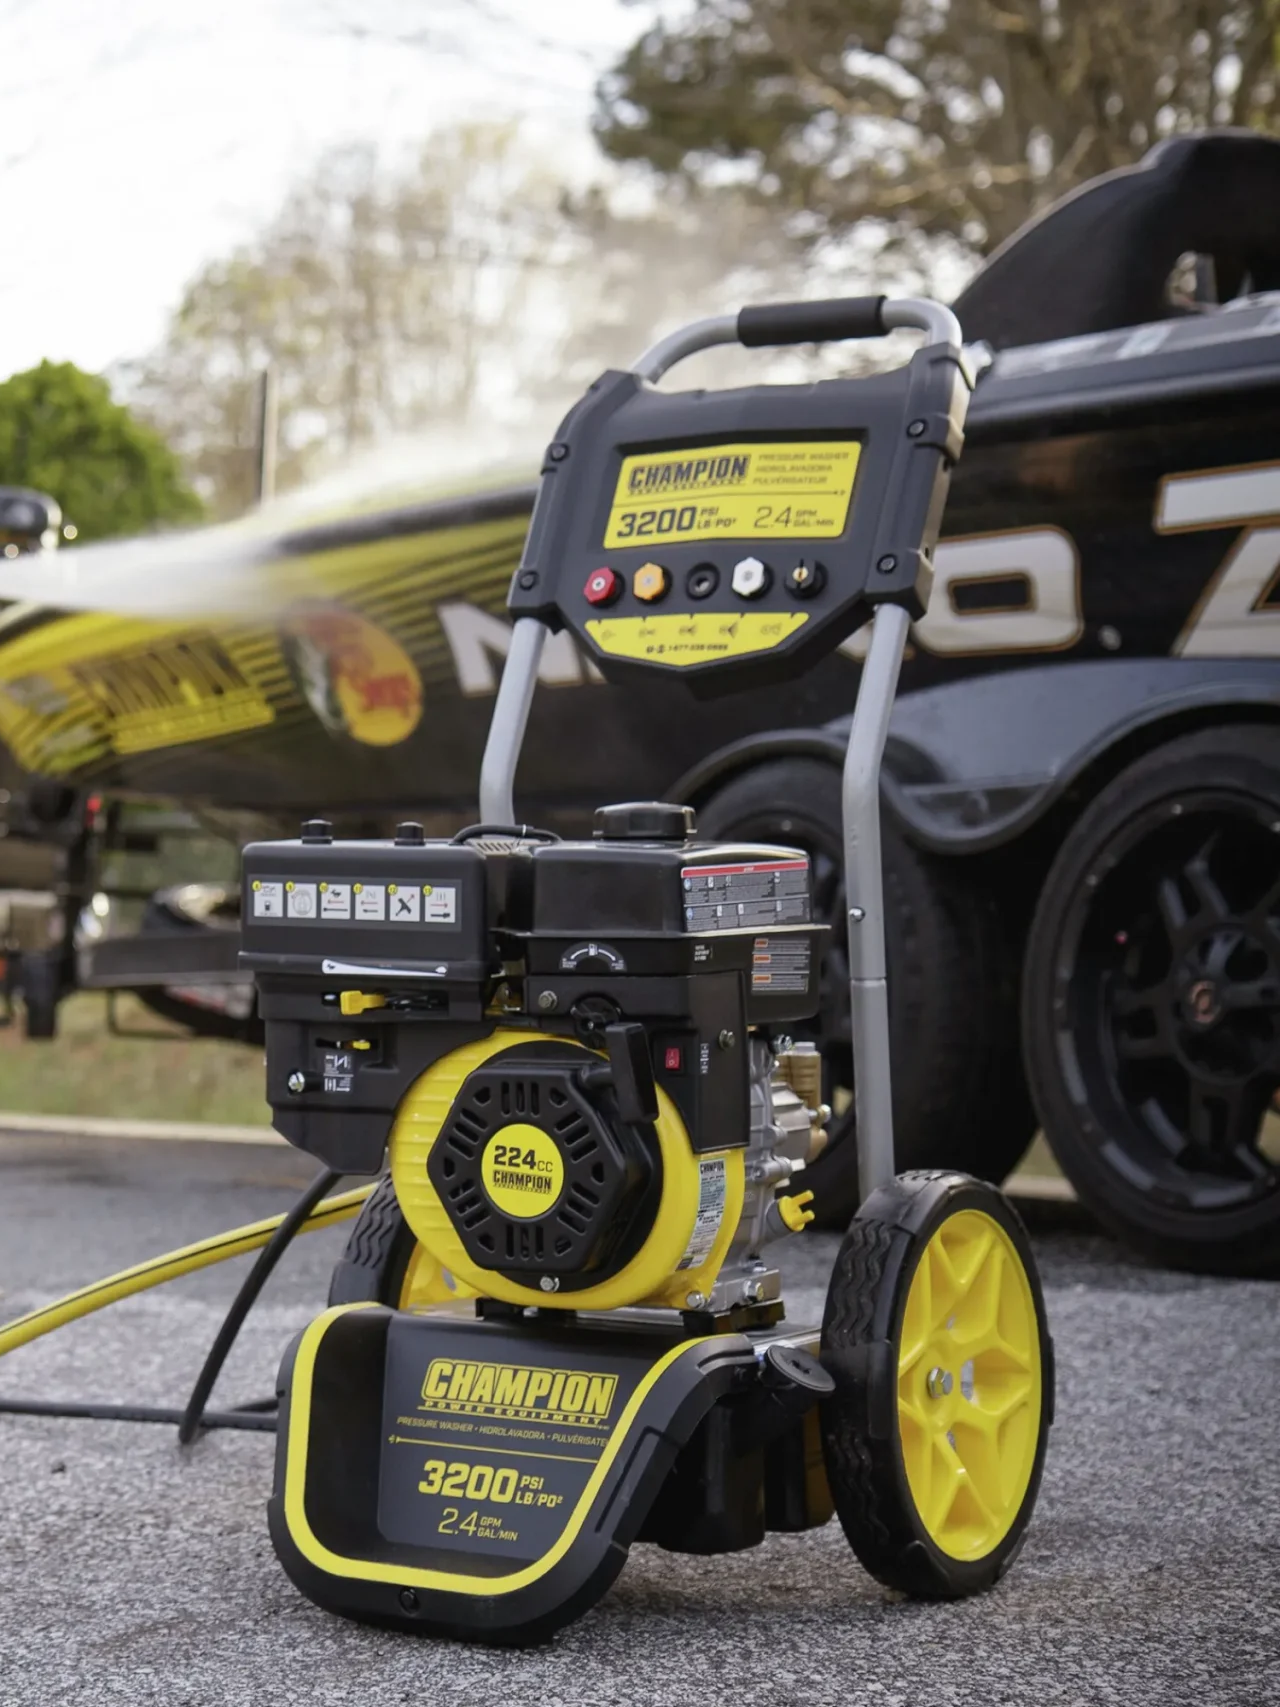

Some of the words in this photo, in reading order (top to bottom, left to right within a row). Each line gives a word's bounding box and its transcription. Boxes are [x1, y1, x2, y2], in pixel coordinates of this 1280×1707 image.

[628, 454, 750, 489] CHAMPION
[617, 506, 697, 537] 3200
[701, 507, 719, 516] PSI
[754, 505, 791, 528] 2.4
[493, 1170, 551, 1190] CHAMPION
[422, 1359, 618, 1418] CHAMPION
[425, 1401, 484, 1414] POWER
[494, 1407, 601, 1424] EQUIPMENT
[397, 1416, 438, 1428] PRESSURE
[440, 1421, 473, 1432] WASHER
[479, 1425, 545, 1440] HIDROLAVADORA
[551, 1432, 609, 1447] PULVÉRISATE
[418, 1459, 519, 1503] 3200
[520, 1475, 544, 1490] PSI
[438, 1508, 478, 1536] 2.4
[480, 1516, 502, 1527] GPM
[477, 1527, 518, 1541] GAL/MIN
